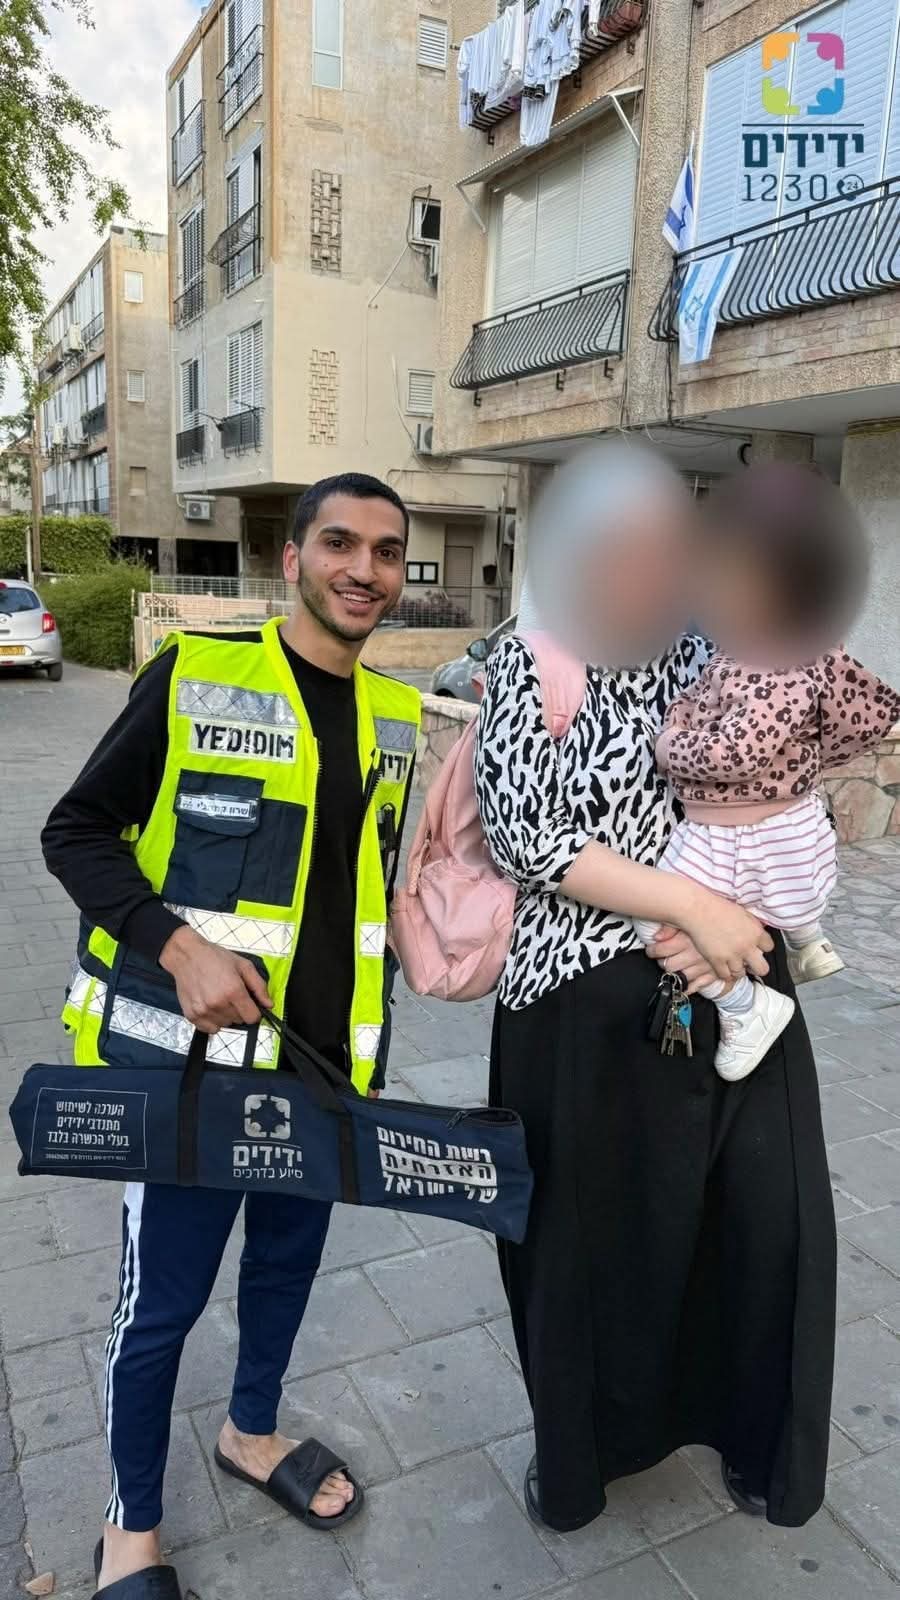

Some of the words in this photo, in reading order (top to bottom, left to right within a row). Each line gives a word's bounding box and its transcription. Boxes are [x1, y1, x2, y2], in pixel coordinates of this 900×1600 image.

[56, 1100, 92, 1114] לשימוש
[94, 1103, 125, 1116] הערכה
[57, 1116, 85, 1129] ידידים
[87, 1118, 121, 1131] מתנדבי
[47, 1129, 69, 1143] בלבד
[71, 1132, 104, 1145] הכשרה
[107, 1133, 130, 1147] בעלי
[376, 1126, 440, 1159] החירום
[232, 1145, 303, 1167] ידידים
[445, 1143, 492, 1164] רשת
[233, 1167, 275, 1179] בדרכים
[279, 1167, 303, 1179] סיוע
[385, 1152, 492, 1180] האזרחית
[382, 1169, 454, 1196] ישראל
[464, 1184, 498, 1204] של
